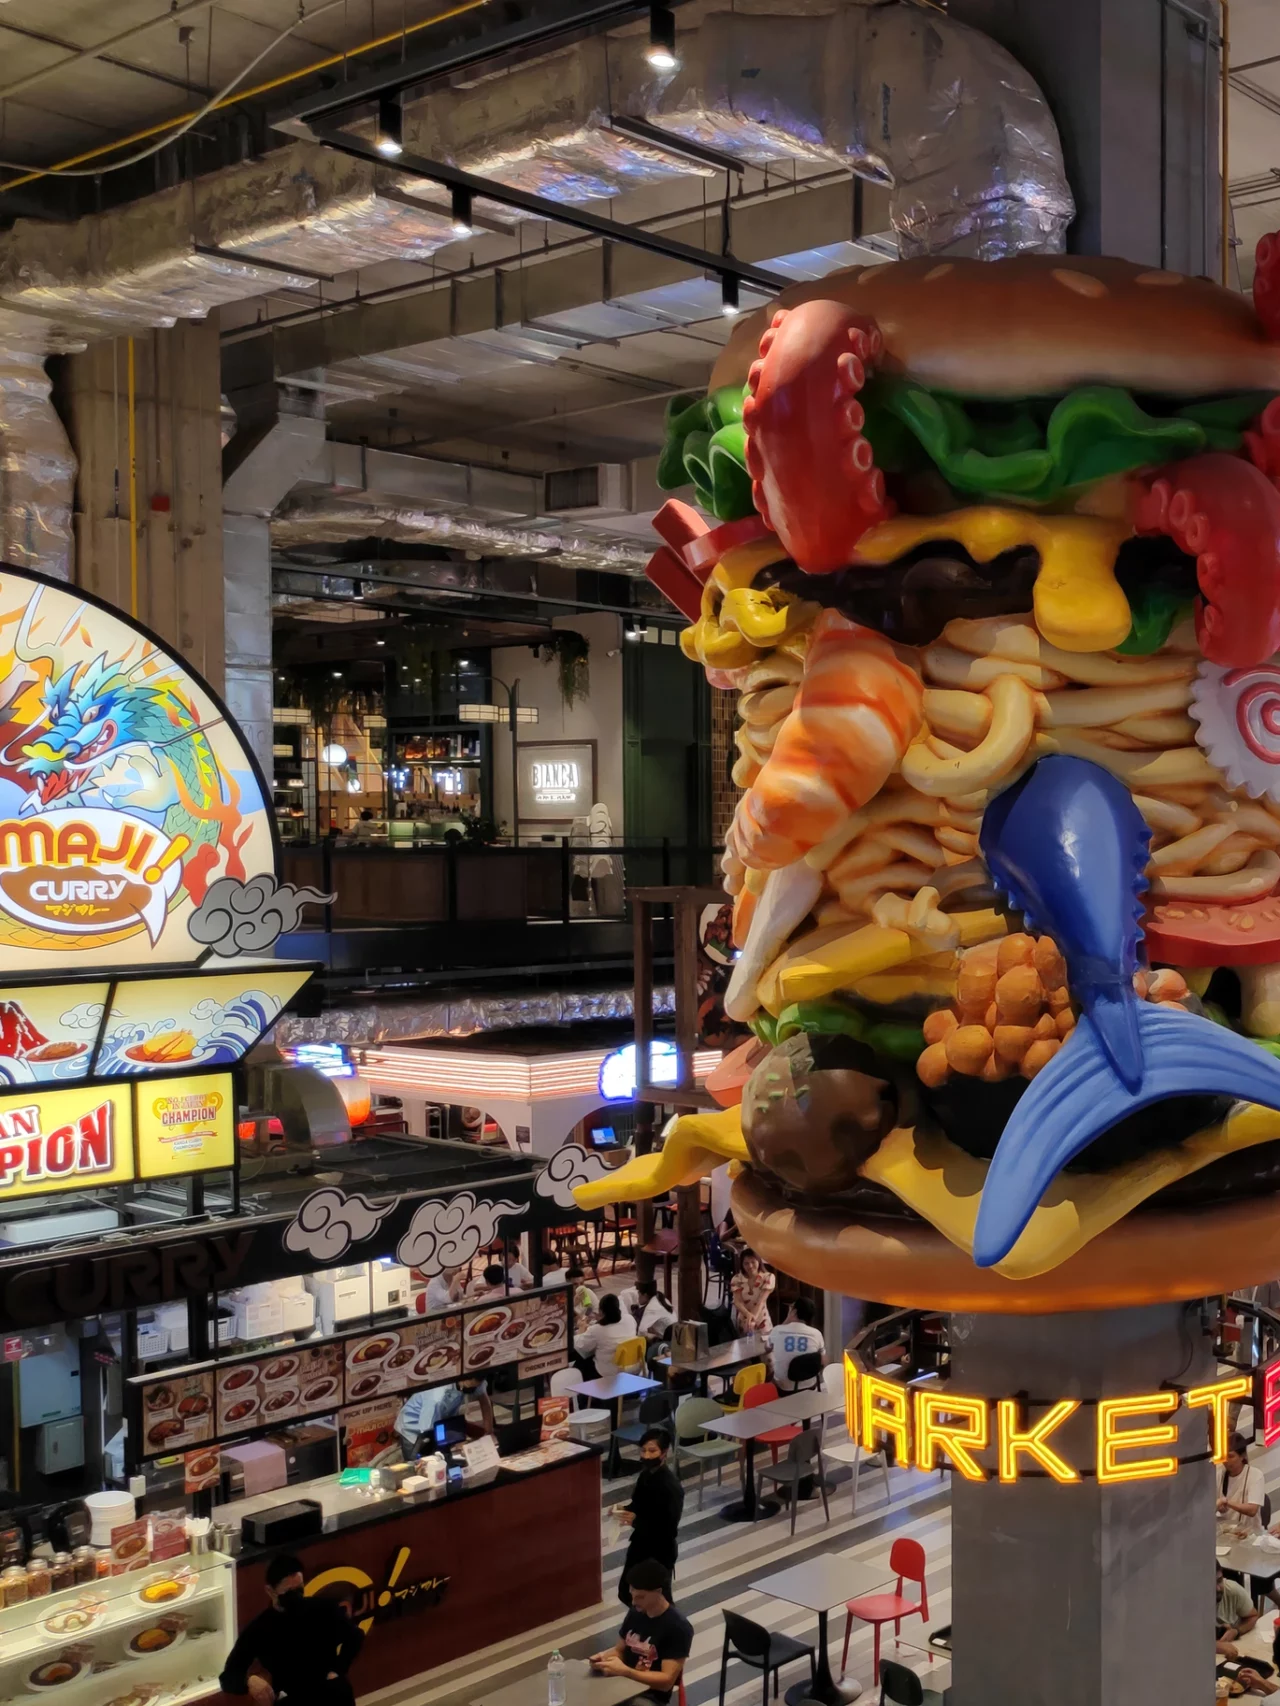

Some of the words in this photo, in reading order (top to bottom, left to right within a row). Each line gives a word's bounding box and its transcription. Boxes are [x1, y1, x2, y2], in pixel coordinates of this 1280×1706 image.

[29, 880, 127, 901] CURRY
[162, 1107, 215, 1126] CHAMPION
[4, 1229, 257, 1325] CURRY
[784, 1336, 808, 1352] 88
[343, 1410, 361, 1420] PICK
[362, 1406, 373, 1415] UP
[373, 1400, 393, 1412] HERE
